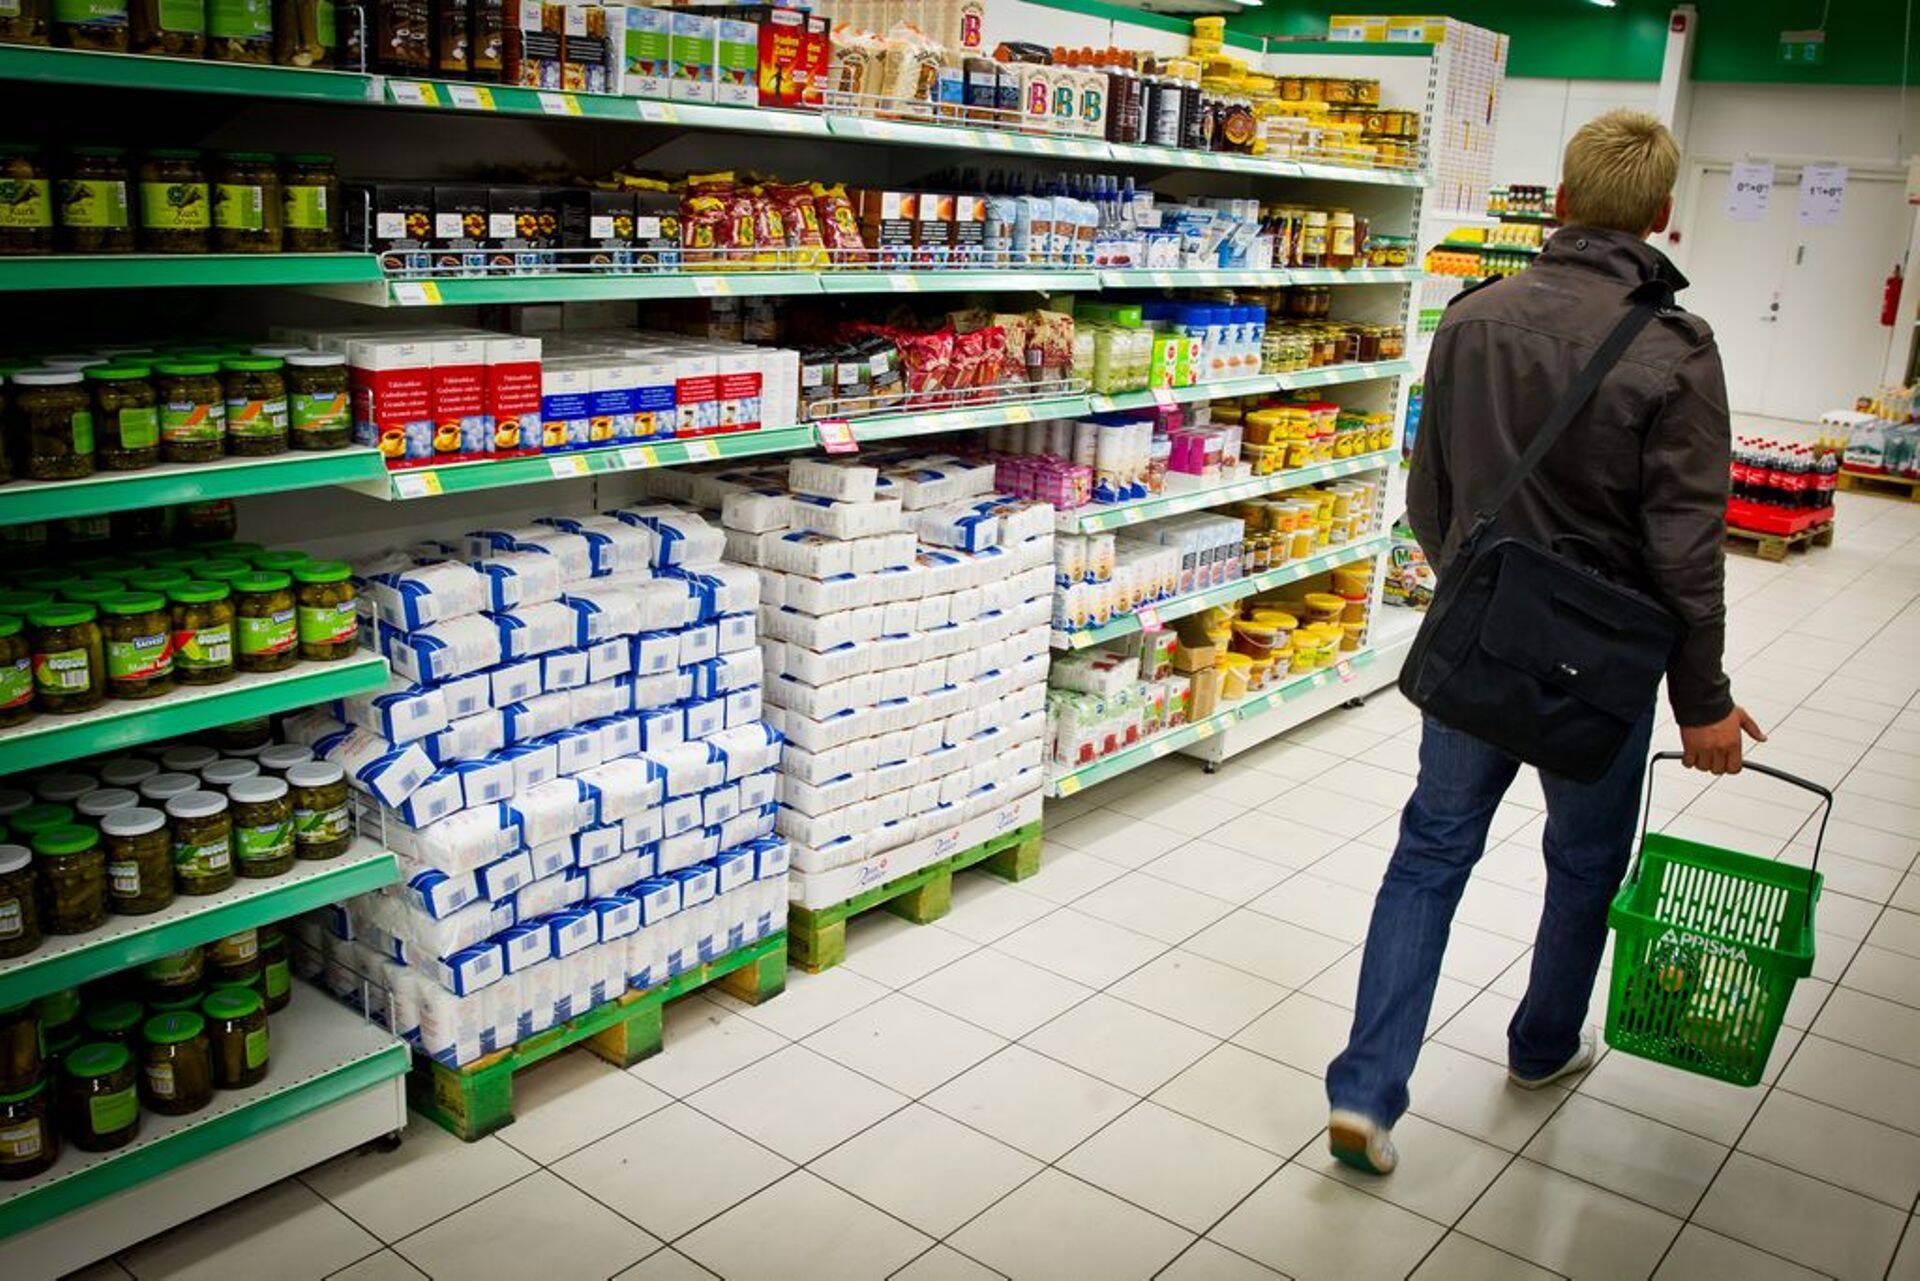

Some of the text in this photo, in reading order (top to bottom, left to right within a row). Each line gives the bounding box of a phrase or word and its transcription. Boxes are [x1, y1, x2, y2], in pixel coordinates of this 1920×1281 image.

[963, 14, 981, 47] B
[1030, 82, 1047, 114] B
[1056, 87, 1073, 118] B
[1083, 90, 1101, 122] B
[1680, 932, 1748, 963] PRISMA
